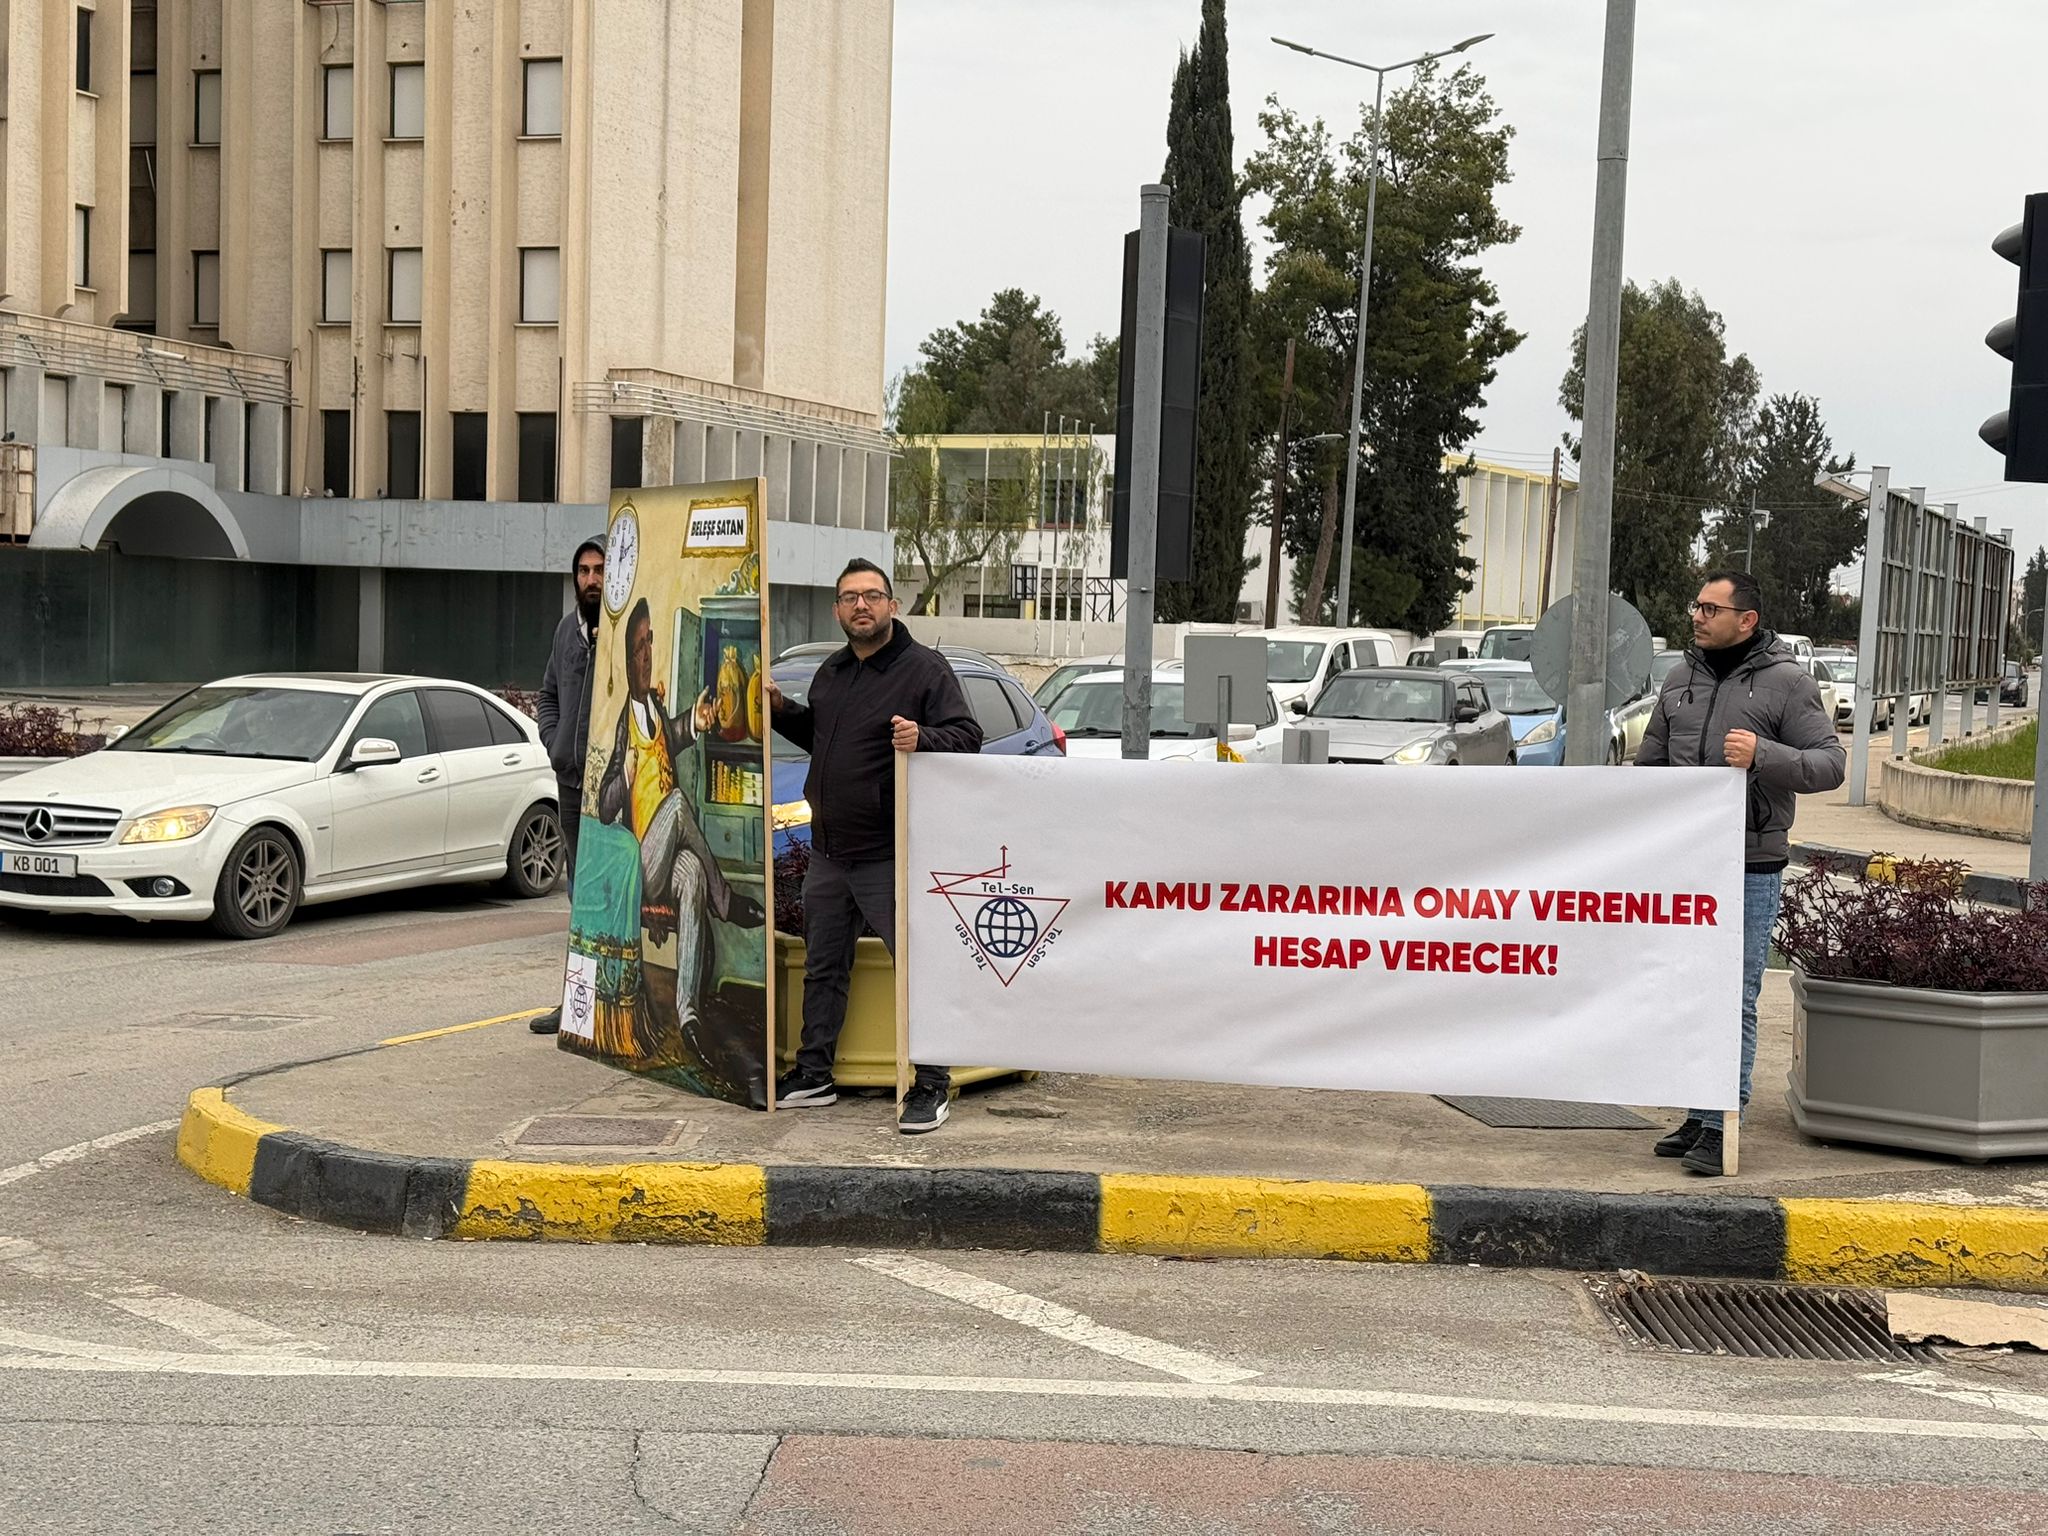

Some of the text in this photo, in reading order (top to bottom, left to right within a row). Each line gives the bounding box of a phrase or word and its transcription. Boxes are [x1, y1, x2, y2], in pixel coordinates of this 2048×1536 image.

[691, 519, 743, 540] BELEŞE SATAN
[13, 856, 60, 873] KB 001
[981, 881, 1034, 895] Tel-Sen
[1105, 881, 1718, 926] KAMU ZARARINA ONAY VERENLER
[955, 923, 987, 971] Tel-Sen
[1027, 927, 1063, 968] Tel-Sen
[1254, 936, 1558, 976] HESAP VERECEK!
